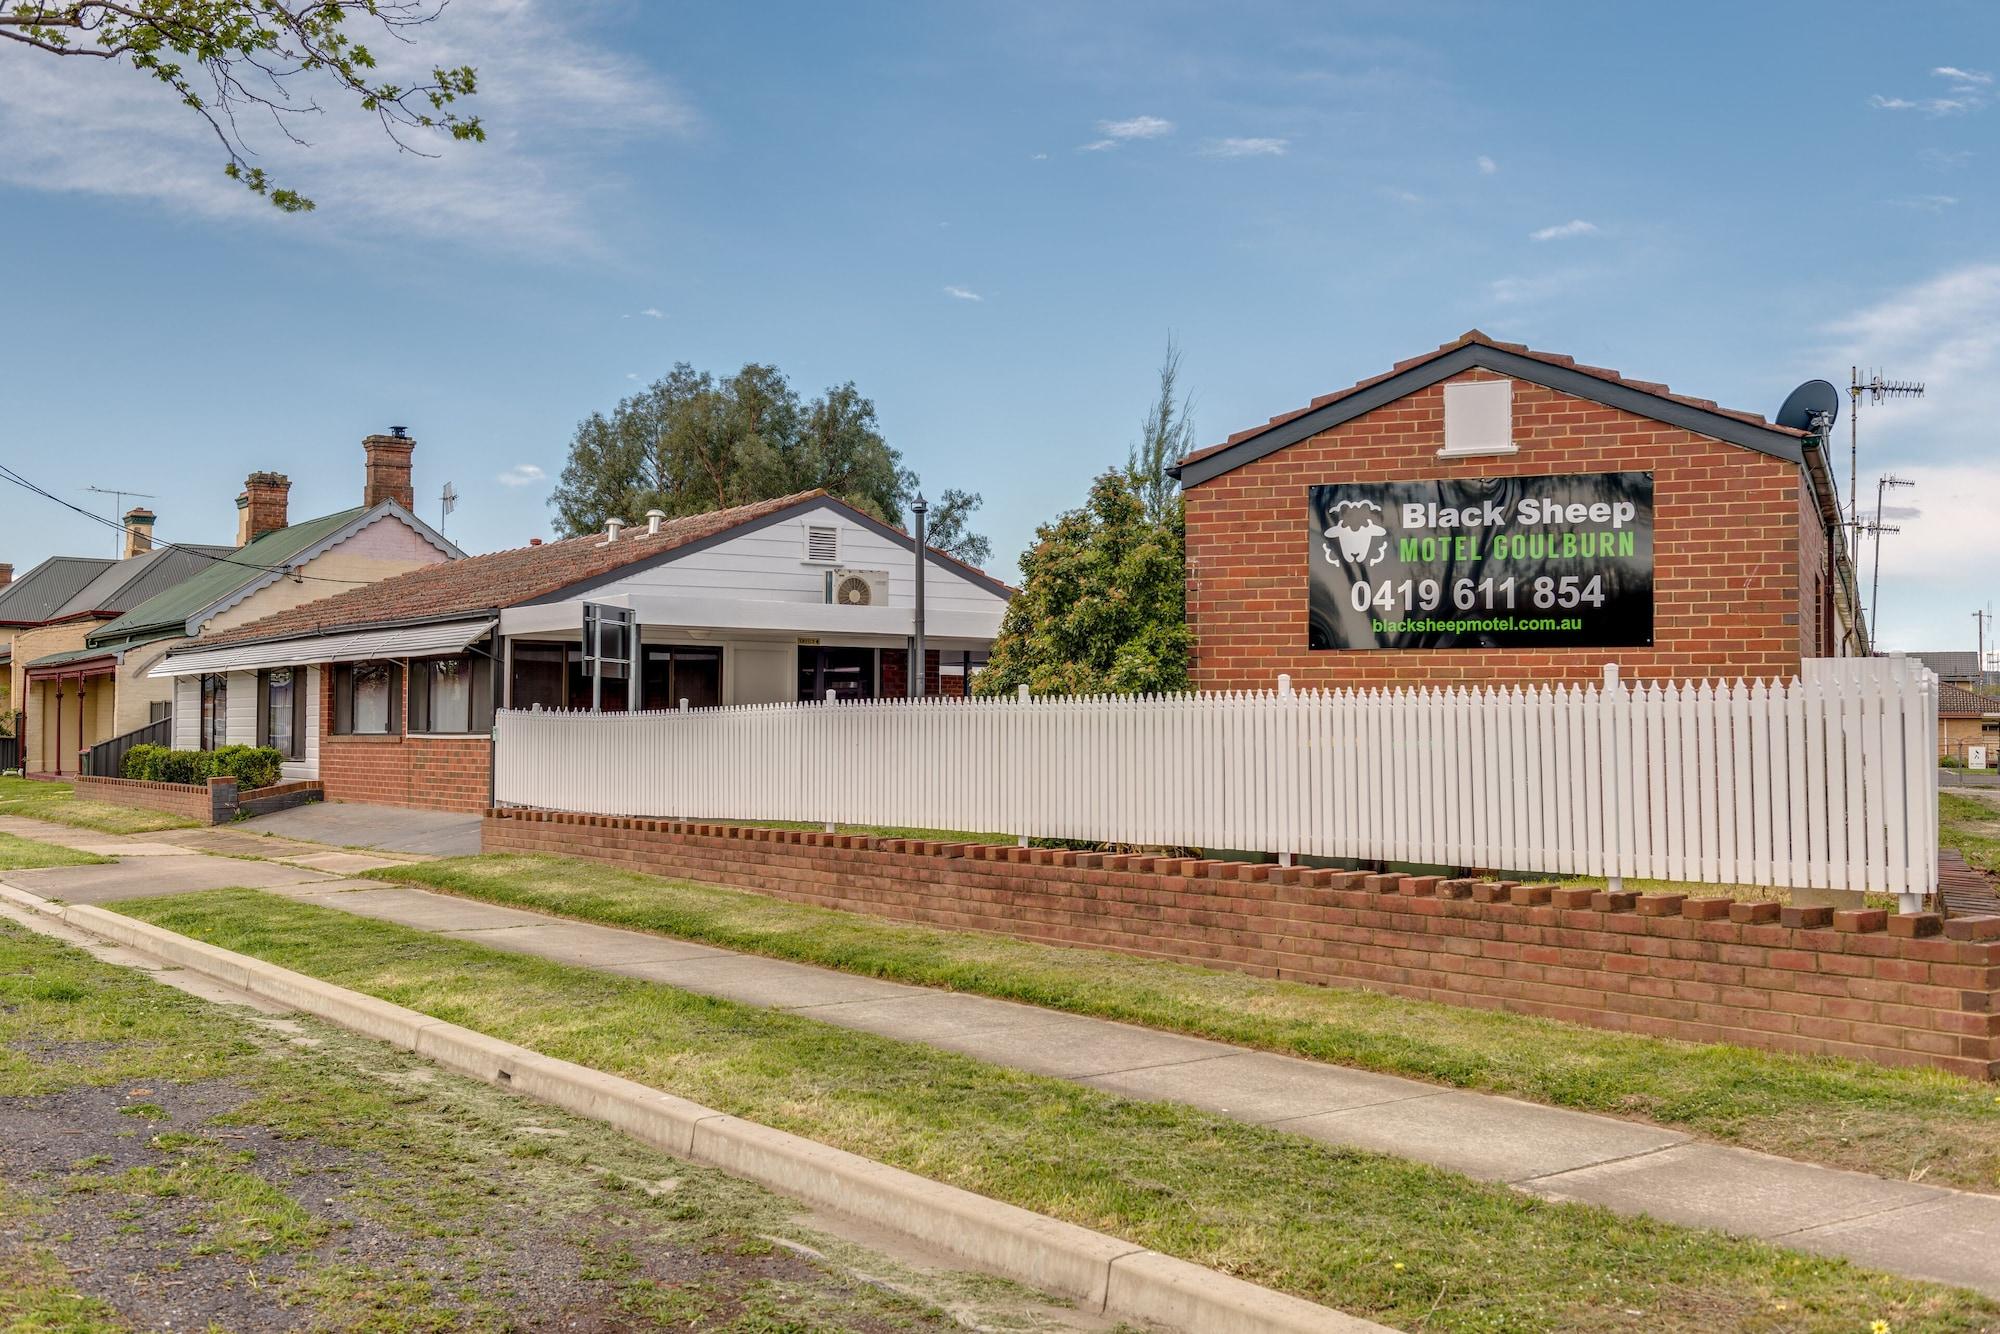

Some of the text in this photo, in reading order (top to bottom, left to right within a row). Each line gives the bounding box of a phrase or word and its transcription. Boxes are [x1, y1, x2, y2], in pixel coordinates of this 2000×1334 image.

[1402, 498, 1635, 529] Black Sheep
[1400, 531, 1635, 563] MOTEL GOULBURN
[1350, 574, 1606, 612] 0419 611 854
[1372, 616, 1582, 635] blacksheepmotel.com.au
